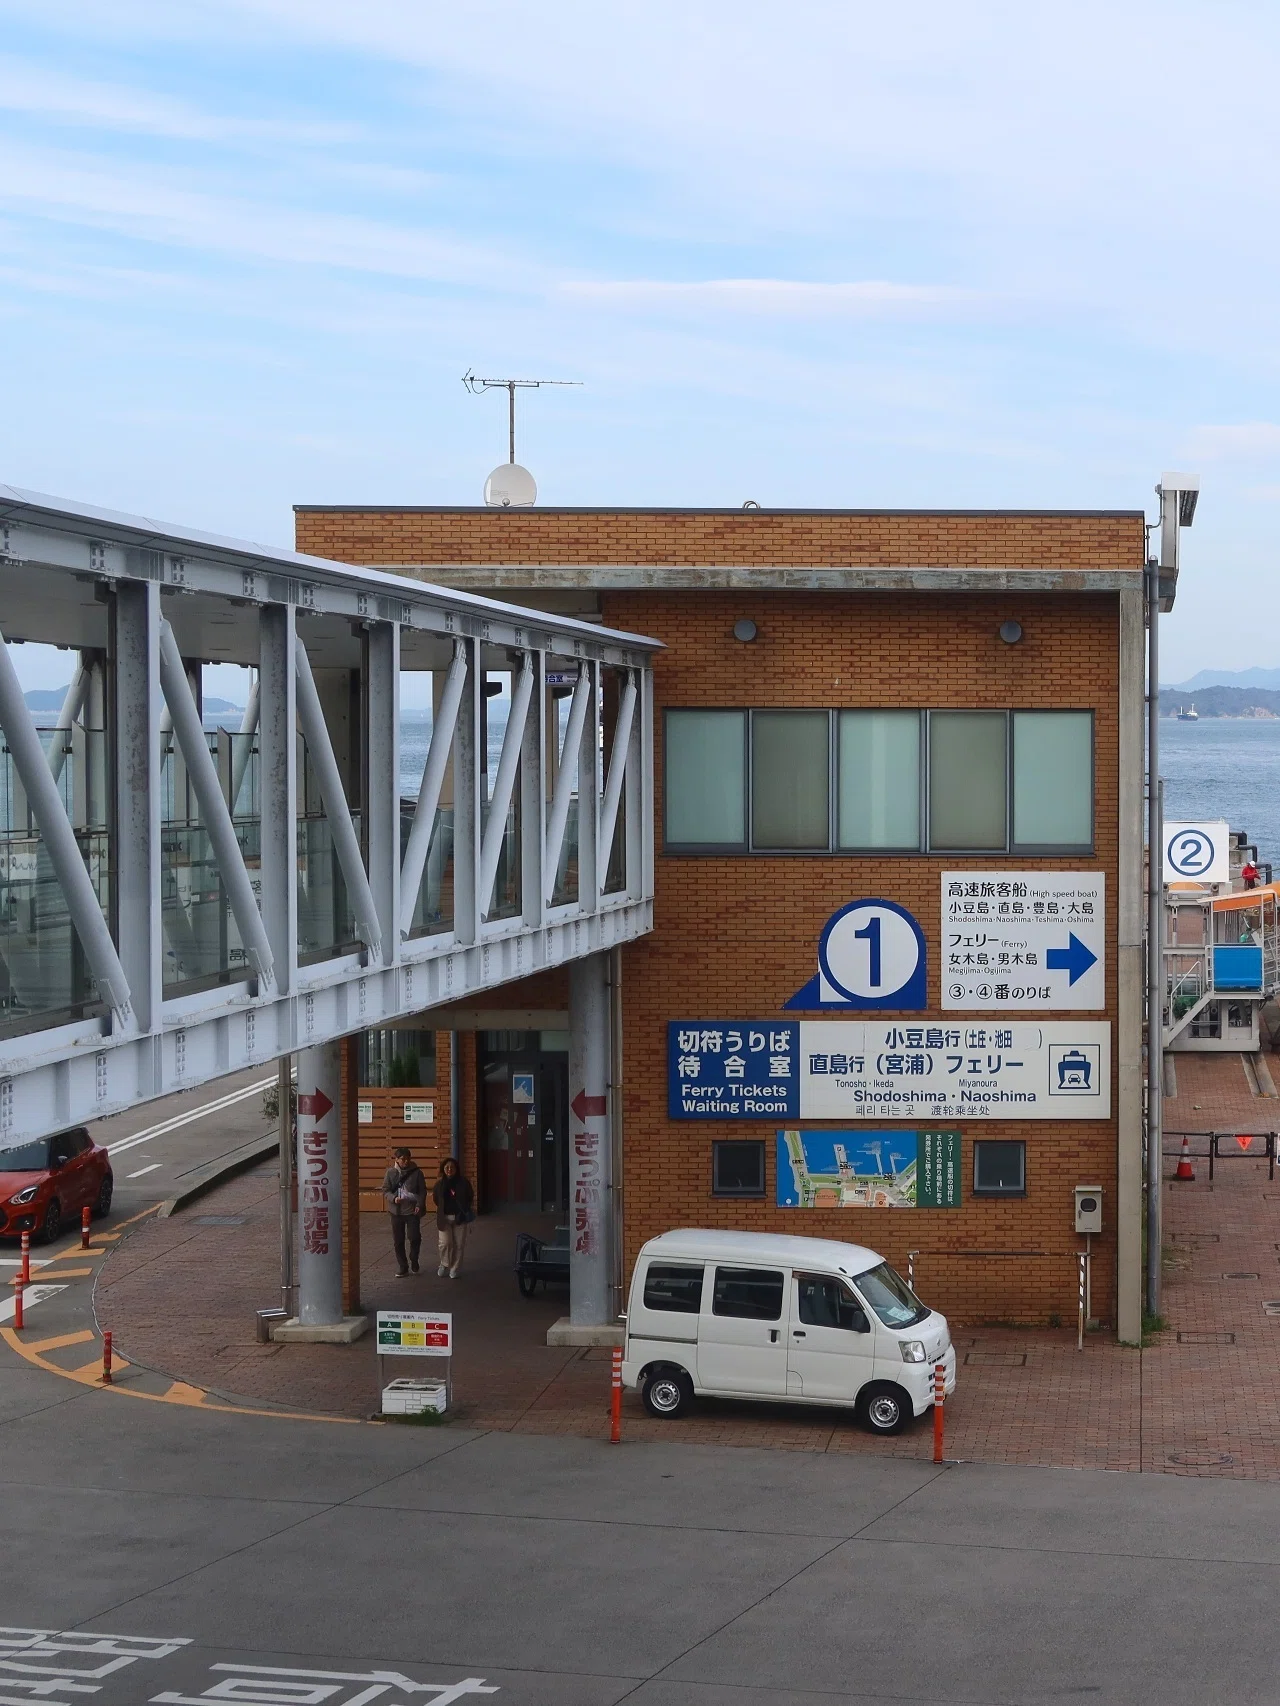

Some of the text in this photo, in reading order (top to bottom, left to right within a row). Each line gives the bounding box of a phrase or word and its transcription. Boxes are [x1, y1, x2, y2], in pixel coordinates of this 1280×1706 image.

[545, 674, 563, 683] 合室
[948, 881, 1098, 899] 高速旅客船 (High speed boat)
[949, 933, 1028, 949] フェリー (Ferry)
[854, 917, 881, 988] 1
[948, 952, 1038, 966] 女木島・男木島
[677, 1030, 792, 1053] 切符うりば
[835, 1079, 894, 1088] Tonosho Ikeda
[958, 1079, 998, 1089] Miyanoura
[681, 1084, 788, 1099] Ferry Tickets
[853, 1090, 1036, 1102] Shodoshima Naoshima
[682, 1100, 788, 1114] Waiting Room
[855, 1105, 915, 1116] 페리 타는 곳
[303, 1131, 329, 1255] きっぷ売場
